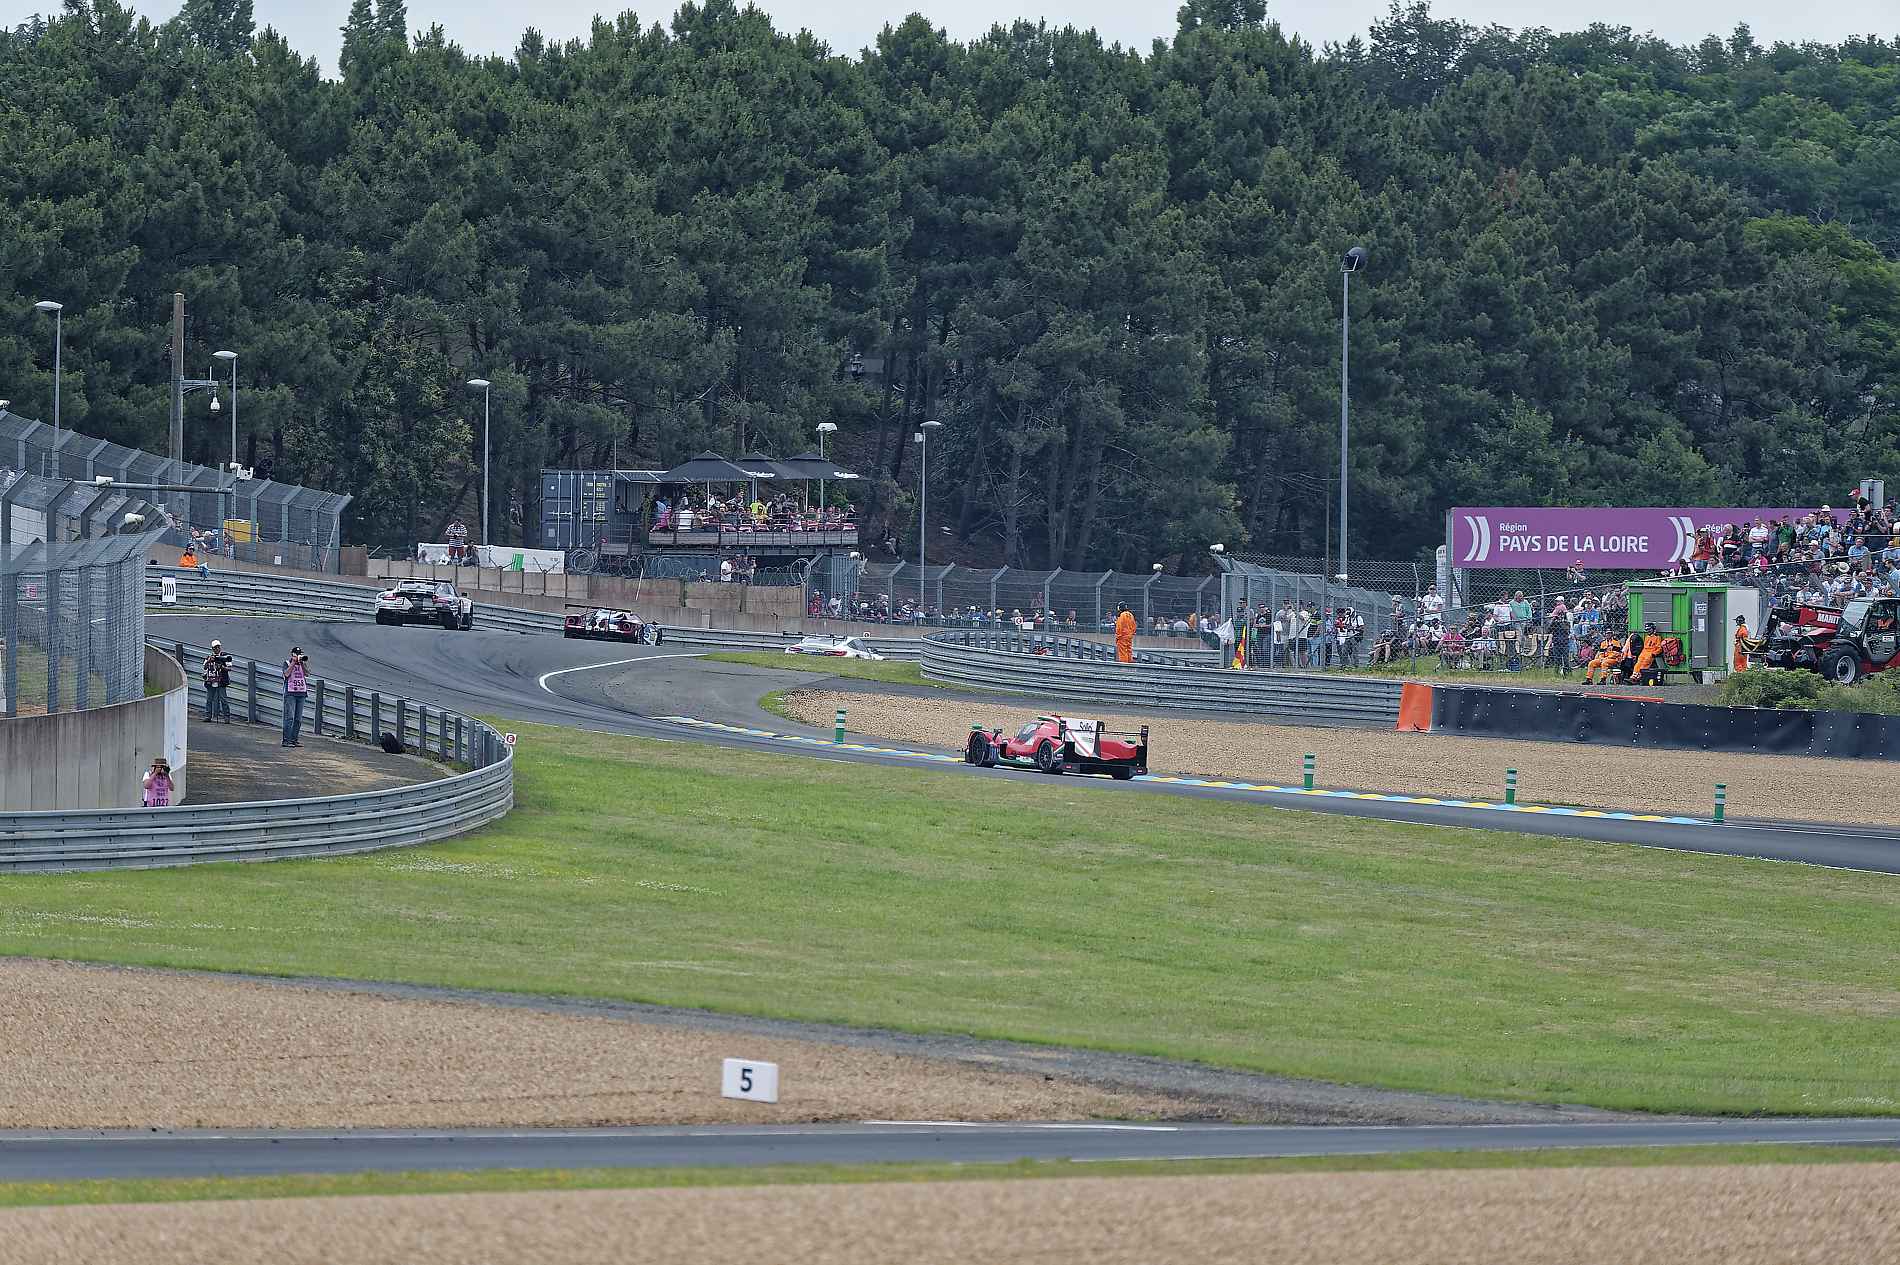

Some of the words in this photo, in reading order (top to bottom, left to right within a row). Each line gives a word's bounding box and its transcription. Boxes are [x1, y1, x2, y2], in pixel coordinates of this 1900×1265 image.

[1500, 522, 1527, 533] Région
[1705, 523, 1724, 533] Régi
[1500, 535, 1541, 552] PAYS
[1547, 535, 1568, 552] DE
[1574, 535, 1595, 552] LA
[1600, 535, 1648, 552] LOIRE
[1817, 612, 1841, 624] MANIT
[740, 1067, 753, 1092] 5
